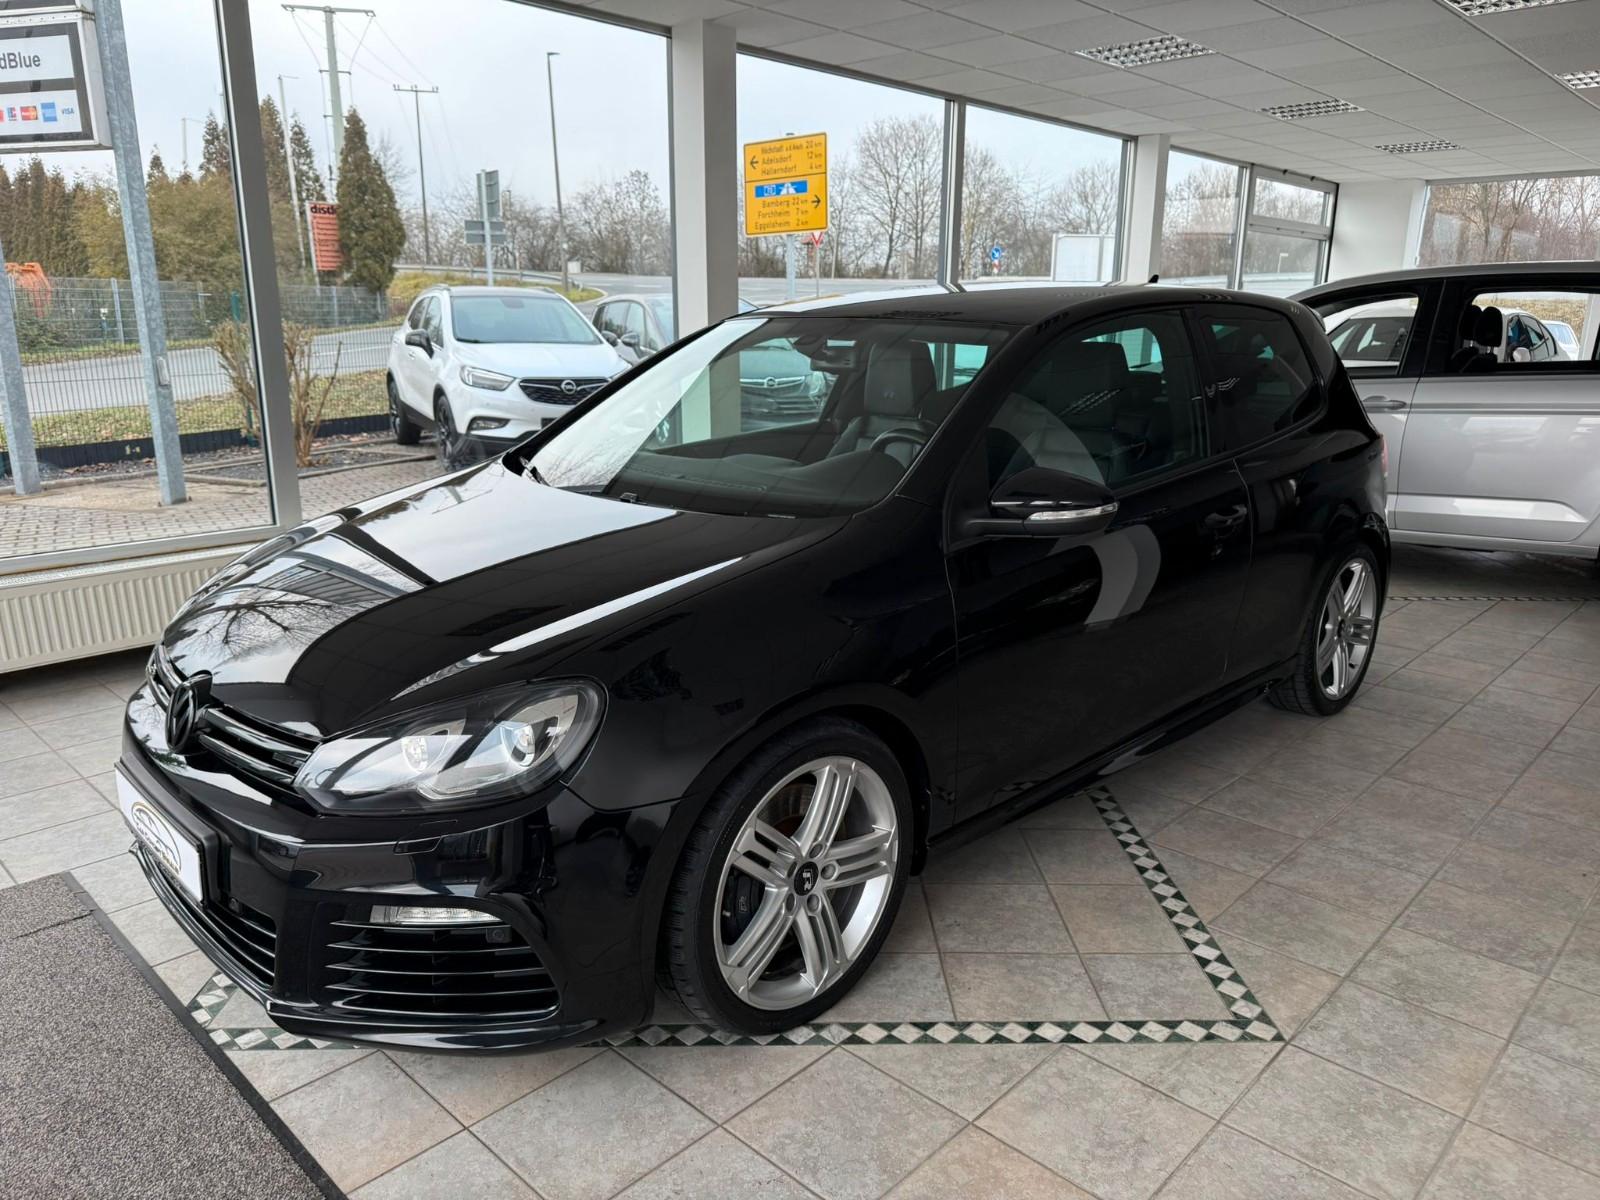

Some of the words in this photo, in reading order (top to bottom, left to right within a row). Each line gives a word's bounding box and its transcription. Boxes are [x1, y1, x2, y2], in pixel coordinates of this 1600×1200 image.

[62, 107, 75, 115] VISA
[762, 154, 792, 165] Adelsdorf
[807, 151, 813, 159] 12
[761, 164, 797, 176] Hallerndorf
[762, 199, 790, 209] Bamberg
[792, 197, 799, 206] 22
[758, 209, 790, 219] Forchheim
[754, 221, 790, 231] Eggolsheim
